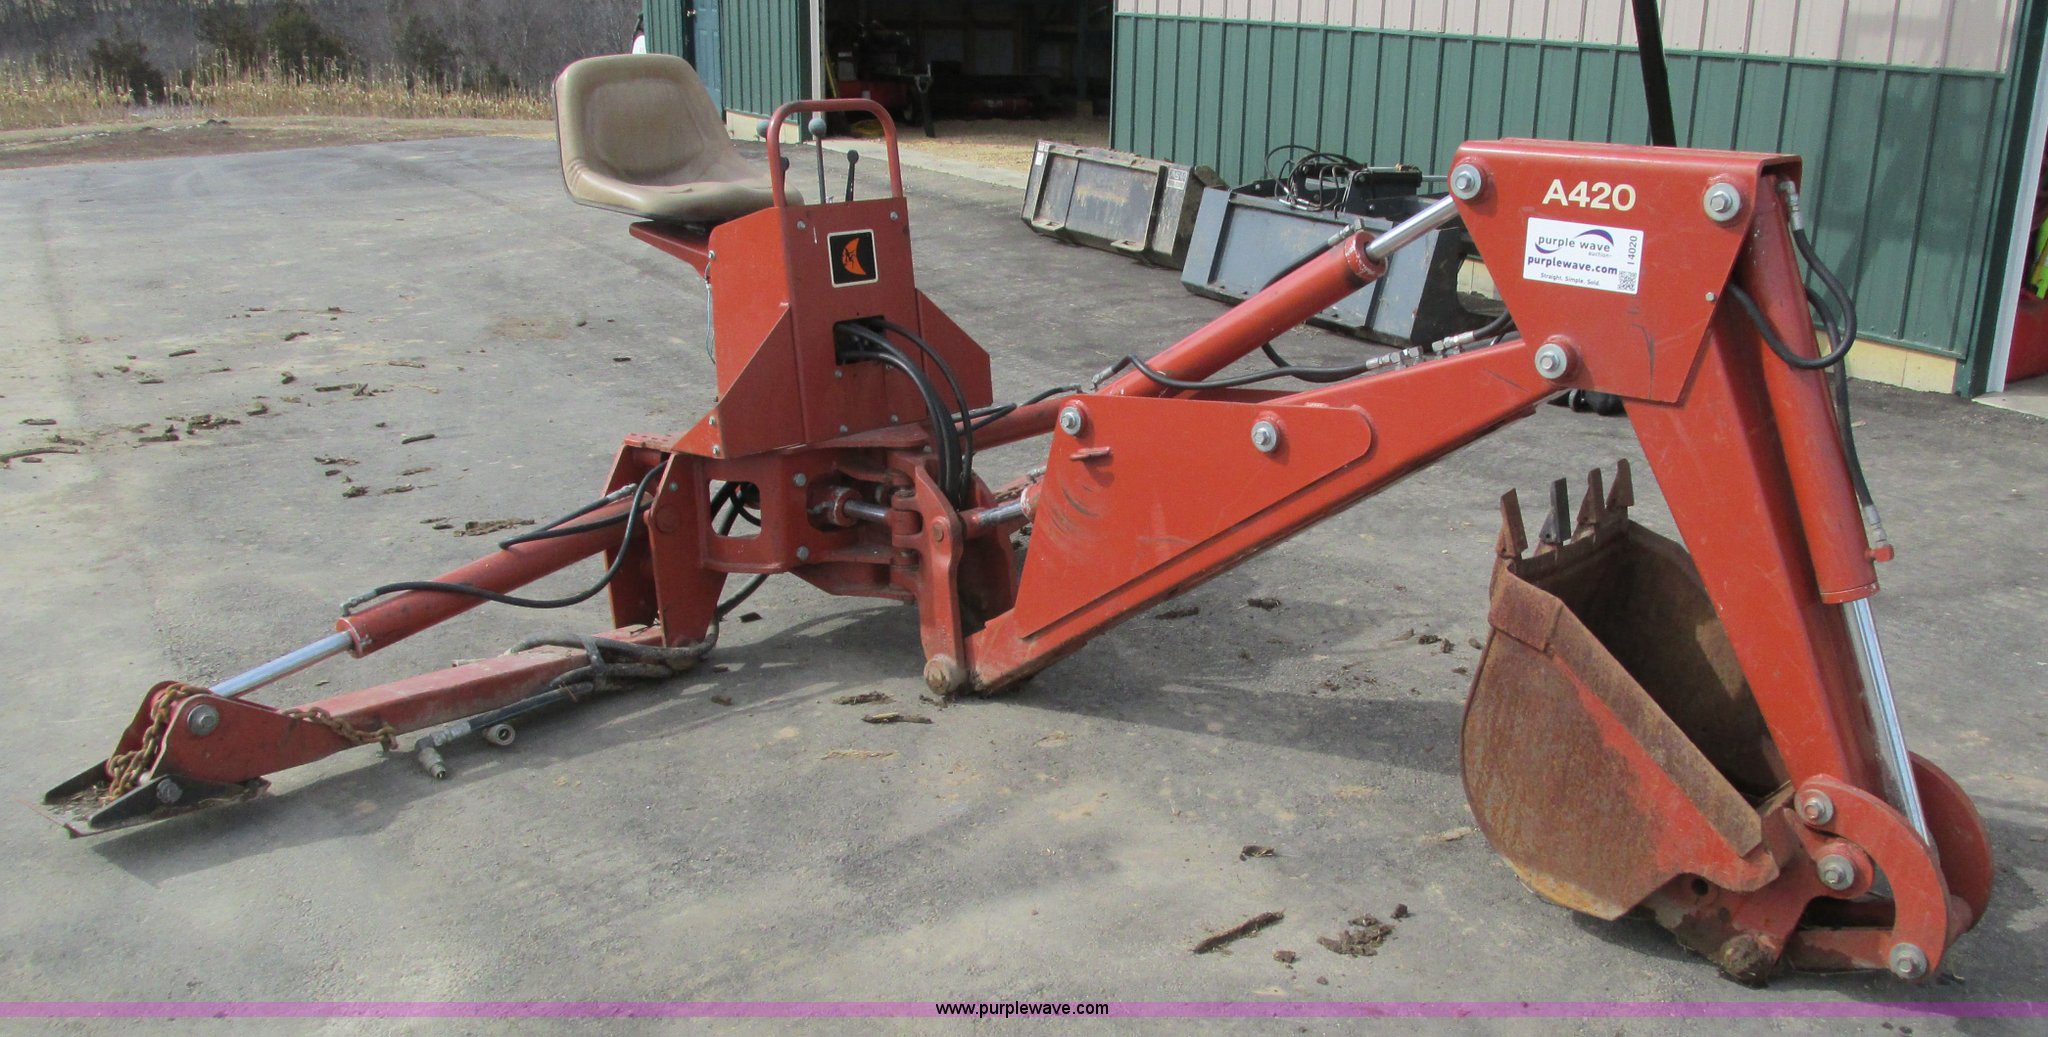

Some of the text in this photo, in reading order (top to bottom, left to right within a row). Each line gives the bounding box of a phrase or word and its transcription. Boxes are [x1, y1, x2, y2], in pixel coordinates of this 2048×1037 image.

[1542, 179, 1636, 211] A420
[1538, 236, 1611, 252] purple wave
[1527, 256, 1618, 275] purplewave.com
